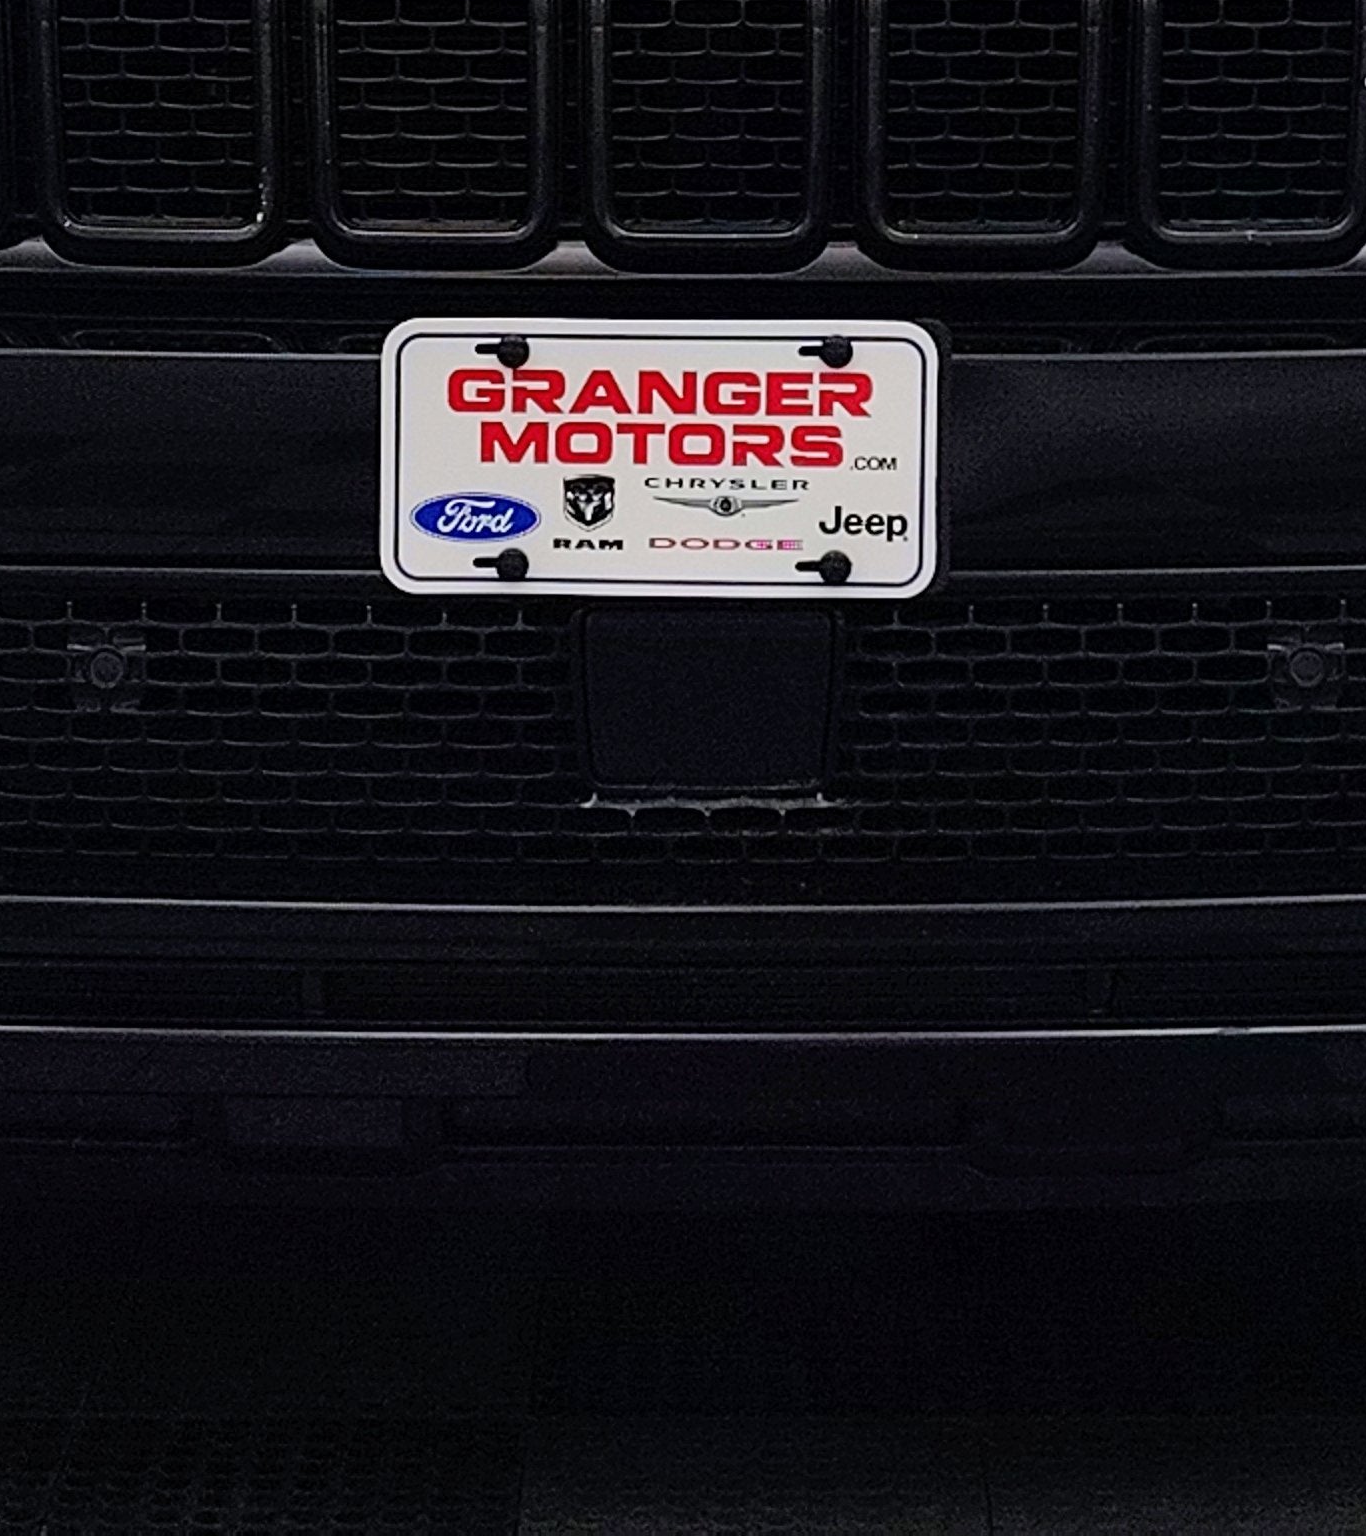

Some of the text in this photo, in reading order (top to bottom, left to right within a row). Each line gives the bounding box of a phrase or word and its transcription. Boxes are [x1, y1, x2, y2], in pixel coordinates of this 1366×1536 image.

[447, 369, 873, 417] GRANGER
[481, 422, 897, 471] MOTORS .COM
[644, 477, 810, 491] CHRYSLER
[437, 498, 514, 534] Ford
[818, 506, 909, 540] Jeep
[552, 538, 624, 551] RAM
[648, 537, 804, 551] DODGE
